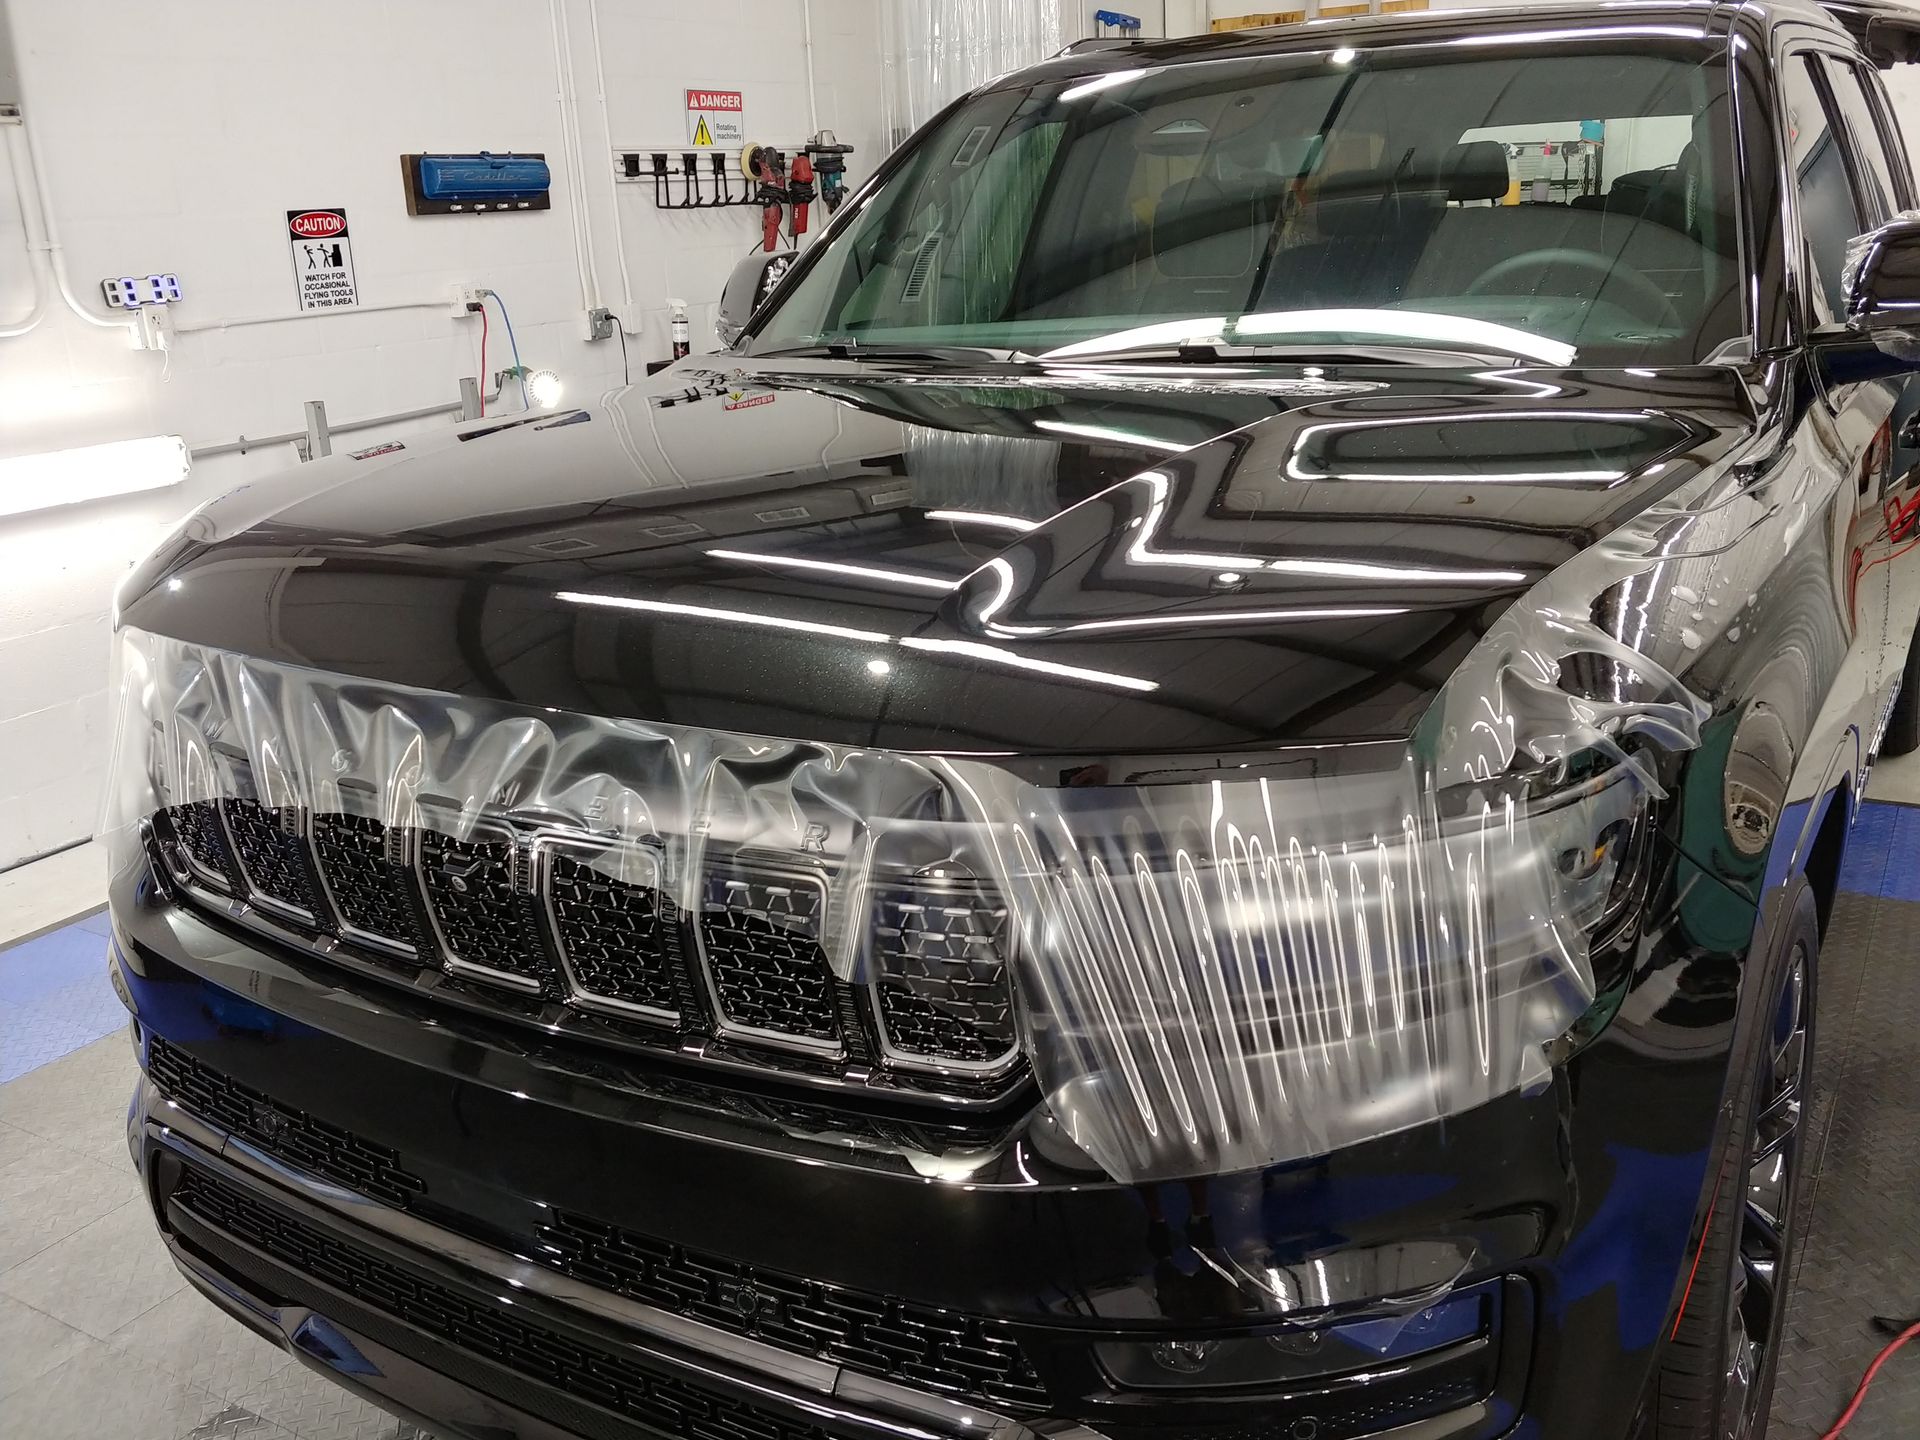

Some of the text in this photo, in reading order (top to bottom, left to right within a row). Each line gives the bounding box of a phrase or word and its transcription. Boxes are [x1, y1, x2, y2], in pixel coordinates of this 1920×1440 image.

[700, 94, 741, 108] DANGER
[716, 123, 737, 132] Rotating
[717, 133, 741, 141] machinery
[295, 217, 340, 232] CAUTION
[305, 272, 346, 281] WATCH FOR
[304, 281, 350, 291] OCCASIONAL
[304, 289, 353, 300] FLYING TOOLS
[317, 299, 332, 307] THIS
